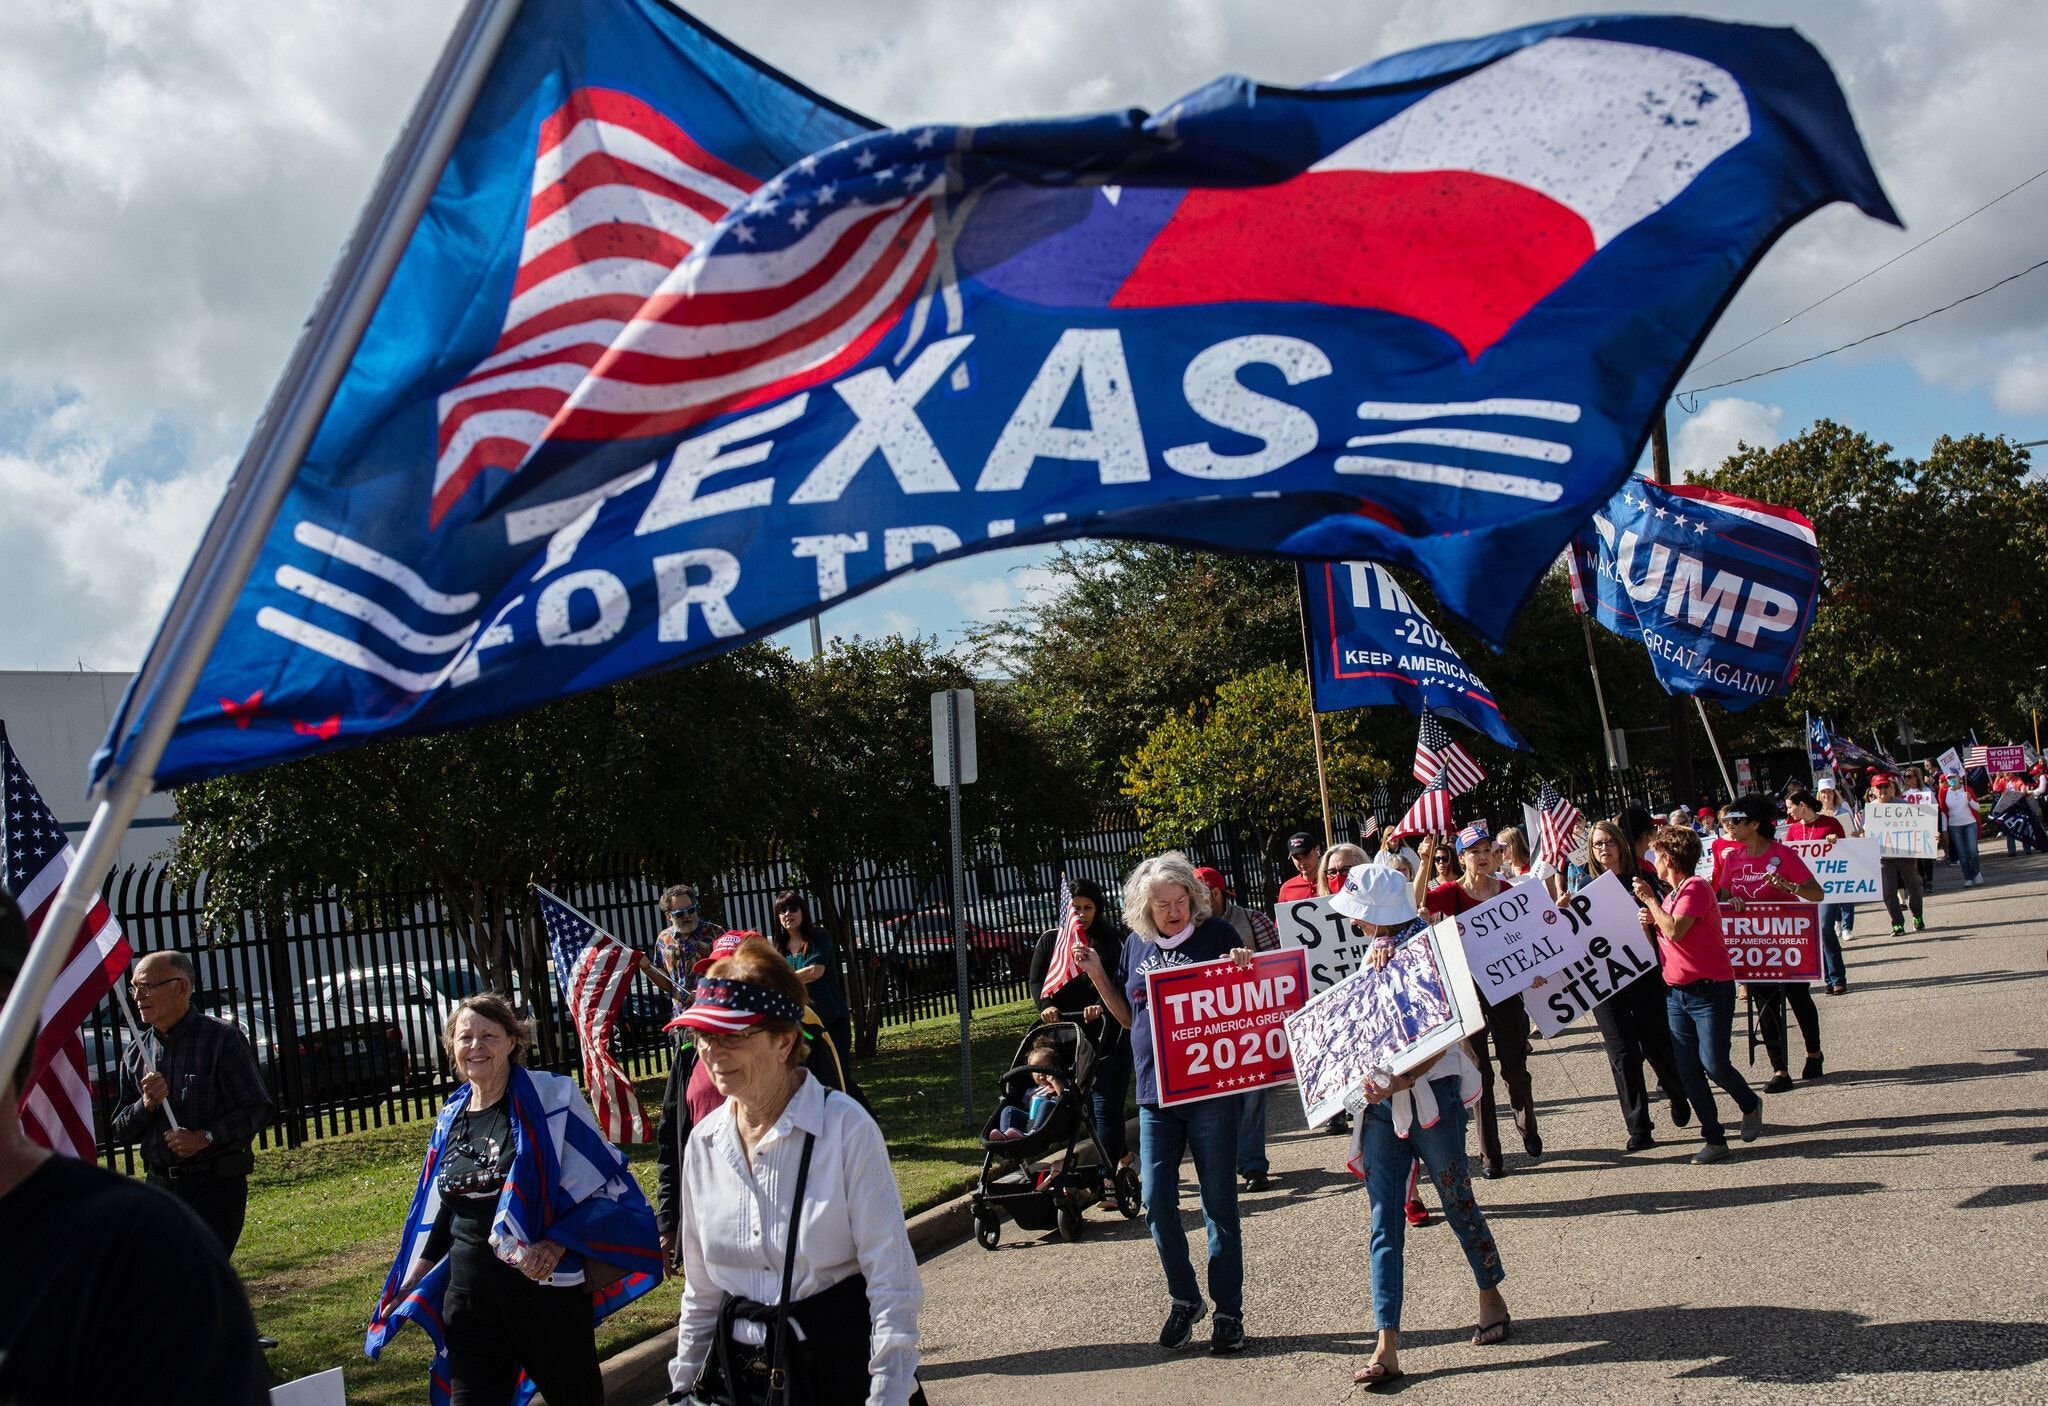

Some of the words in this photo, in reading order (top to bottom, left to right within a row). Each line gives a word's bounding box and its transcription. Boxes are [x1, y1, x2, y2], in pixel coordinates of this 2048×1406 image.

[505, 327, 1333, 583] TEXAS
[1395, 618, 1460, 659] -202
[1345, 650, 1392, 666] KEEP
[1398, 655, 1468, 682] AMERICA
[1643, 628, 1698, 670] GREAT
[1698, 658, 1775, 696] AGAIN!
[1990, 748, 2021, 757] WOMEN
[1873, 806, 1925, 818] LEGAL
[1815, 860, 1848, 873] THE
[1823, 879, 1877, 894] STEAL
[1470, 893, 1530, 938] STOP
[1721, 917, 1811, 936] TRUMP
[1504, 931, 1523, 945] the
[1135, 954, 1158, 975] ONE
[1486, 935, 1564, 986] STEAL
[1728, 947, 1802, 967] 2020
[1548, 944, 1652, 1024] STEAL
[1164, 975, 1296, 1025] TRUMP
[1172, 1026, 1202, 1041] KEEP
[1204, 1018, 1255, 1036] AMERICA
[1186, 1028, 1288, 1075] 2020
